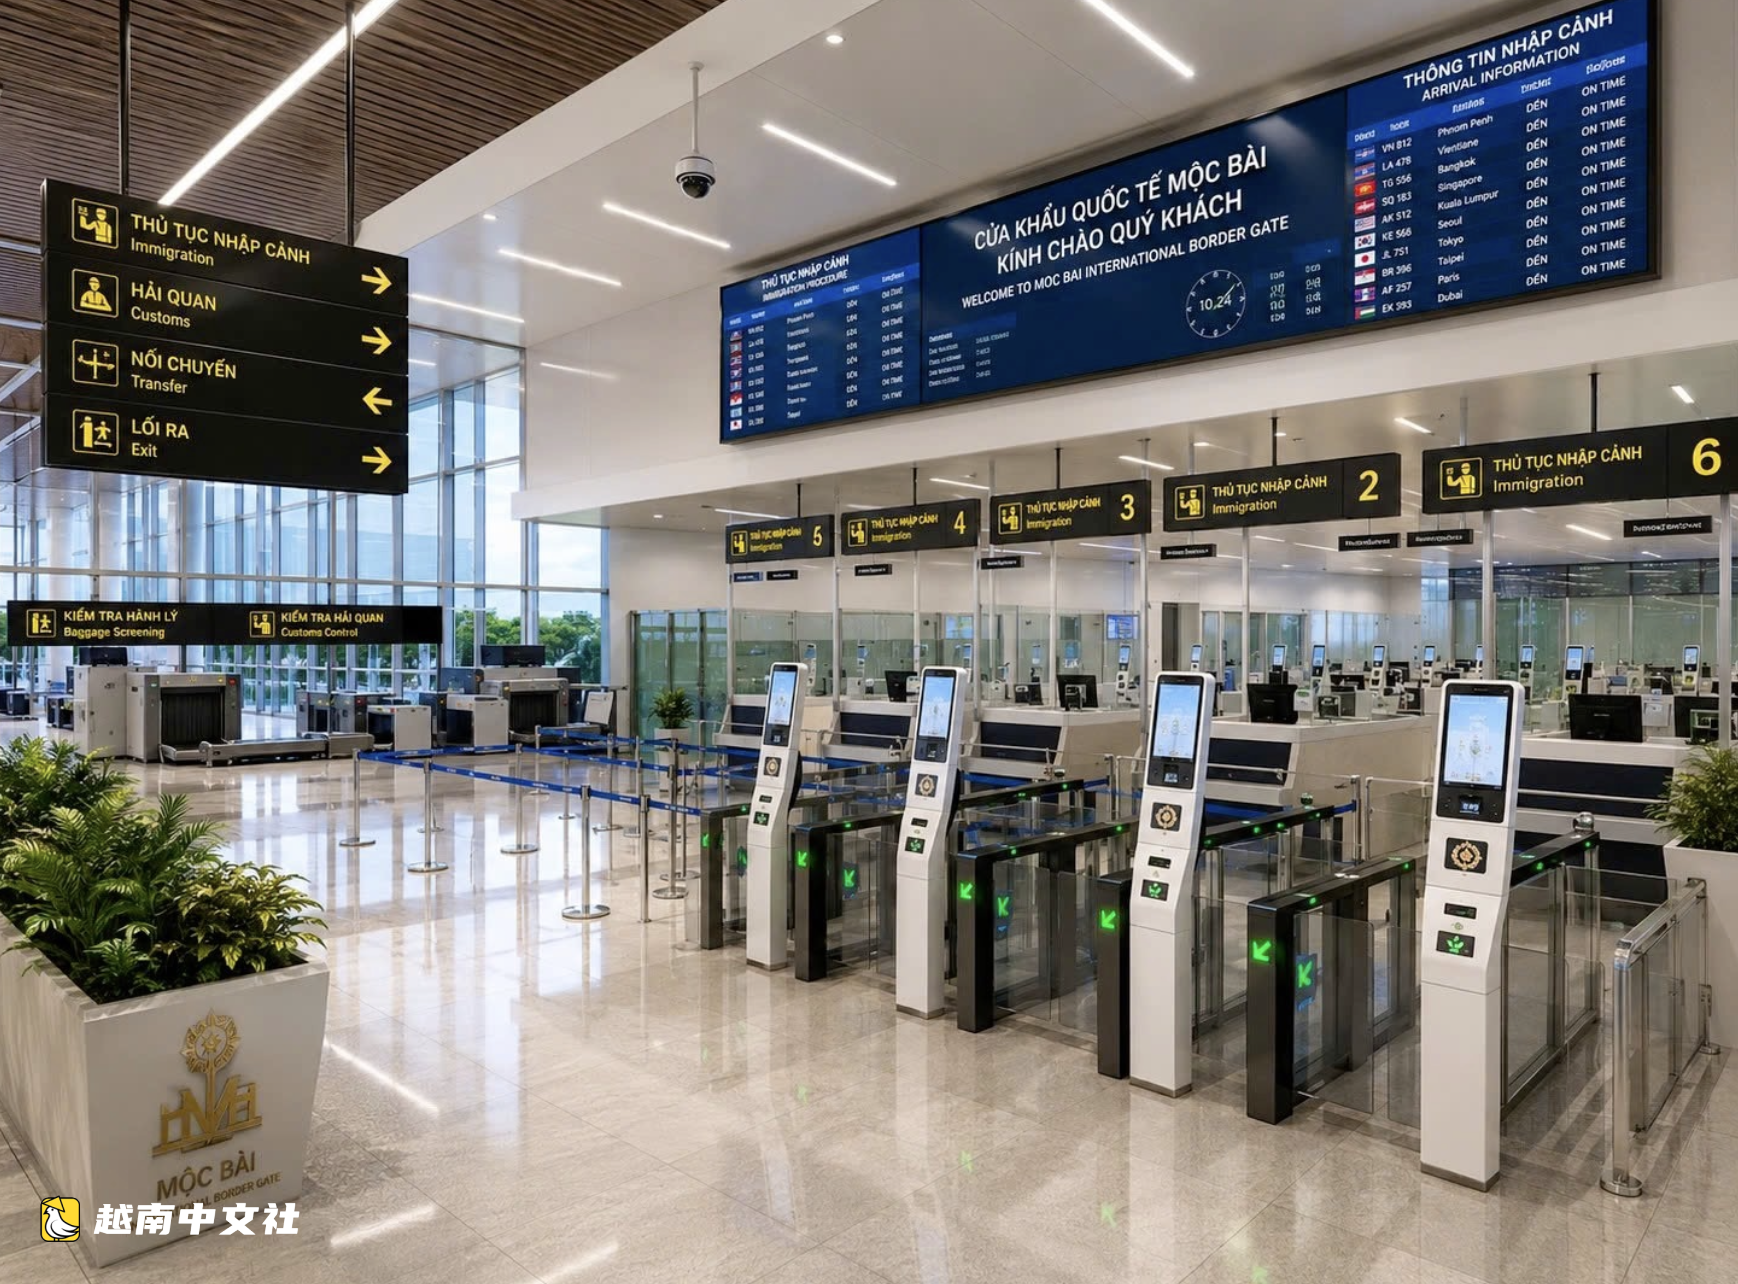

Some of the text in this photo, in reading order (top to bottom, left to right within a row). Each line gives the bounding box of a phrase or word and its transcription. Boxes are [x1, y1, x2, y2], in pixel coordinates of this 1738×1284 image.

[1403, 9, 1613, 88] THÔNG TIN NHẬP CẢNH
[1421, 77, 1477, 102] ARRIVAL
[1481, 42, 1580, 84] INFORMATION
[1382, 142, 1394, 153] VN
[1438, 121, 1468, 137] Phnom
[1470, 115, 1493, 128] Penh
[1581, 84, 1598, 96] ON
[1600, 75, 1626, 92] TIME
[1382, 161, 1394, 171] LA
[1438, 138, 1479, 156] Vientiane
[1581, 104, 1598, 117] ON
[1600, 96, 1626, 112] TIME
[1382, 178, 1394, 188] TG
[1438, 156, 1476, 174] Bangkok
[1581, 124, 1598, 137] ON
[1600, 116, 1626, 133] TIME
[1438, 175, 1483, 192] Singapore
[1581, 144, 1598, 156] ON
[1600, 136, 1626, 153] TIME
[974, 144, 1266, 250] CỬA KHẨU QUỐC TẾ MỘC BÀI
[1438, 198, 1462, 211] Kuala
[1464, 190, 1499, 204] Lumpur
[1581, 164, 1598, 176] ON
[1600, 157, 1626, 172] TIME
[1438, 216, 1462, 230] Seoul
[1581, 184, 1598, 196] ON
[1600, 177, 1626, 192] TIME
[131, 214, 310, 265] THỦ TỤC NHẬP CẢNH
[997, 189, 1242, 274] KÍNH CHÀO QUÝ KHÁCH
[1393, 246, 1409, 257] 751
[1438, 235, 1464, 248] Tokyo
[1581, 204, 1598, 216] ON
[1600, 197, 1626, 212] TIME
[1438, 252, 1464, 266] Taipei
[1581, 224, 1598, 236] ON
[1600, 217, 1626, 232] TIME
[131, 238, 214, 266] Immigration
[962, 215, 1289, 309] WELCOME TO MOC BAI INTERNATIONAL BORDER GATE
[1381, 285, 1394, 295] AF
[1438, 272, 1460, 285] Paris
[1581, 244, 1598, 256] ON
[1600, 238, 1626, 252] TIME
[132, 281, 216, 312] HẢI QUAN
[1438, 290, 1462, 303] Dubai
[1581, 264, 1598, 275] ON
[1600, 259, 1626, 272] TIME
[131, 306, 191, 328] Customs
[132, 348, 237, 379] NỐI CHUYẾN
[131, 374, 188, 394] Transfer
[132, 416, 189, 439] LỐI RA
[132, 443, 157, 458] Exit
[1493, 437, 1722, 476] THỦ TỤC NHẬP CẢNH 6
[1212, 470, 1379, 502] THỦ TỤC NHẬP CẢNH 2
[1494, 474, 1583, 492] Immigration
[954, 510, 966, 534] 4
[1026, 516, 1072, 530] Immigration
[1120, 493, 1135, 521] 3
[1212, 499, 1277, 515] Immigration
[813, 525, 822, 546] 5
[99, 611, 123, 621] TRA
[126, 609, 161, 622] HÀNH
[164, 609, 178, 622] LÝ
[310, 613, 332, 622] TRA
[355, 613, 384, 624] QUAN
[64, 627, 165, 639] Baggage Screening
[281, 627, 358, 637] Customs Control
[156, 1150, 255, 1201] MỘC BÀI
[214, 1171, 281, 1203] BORDER GATE
